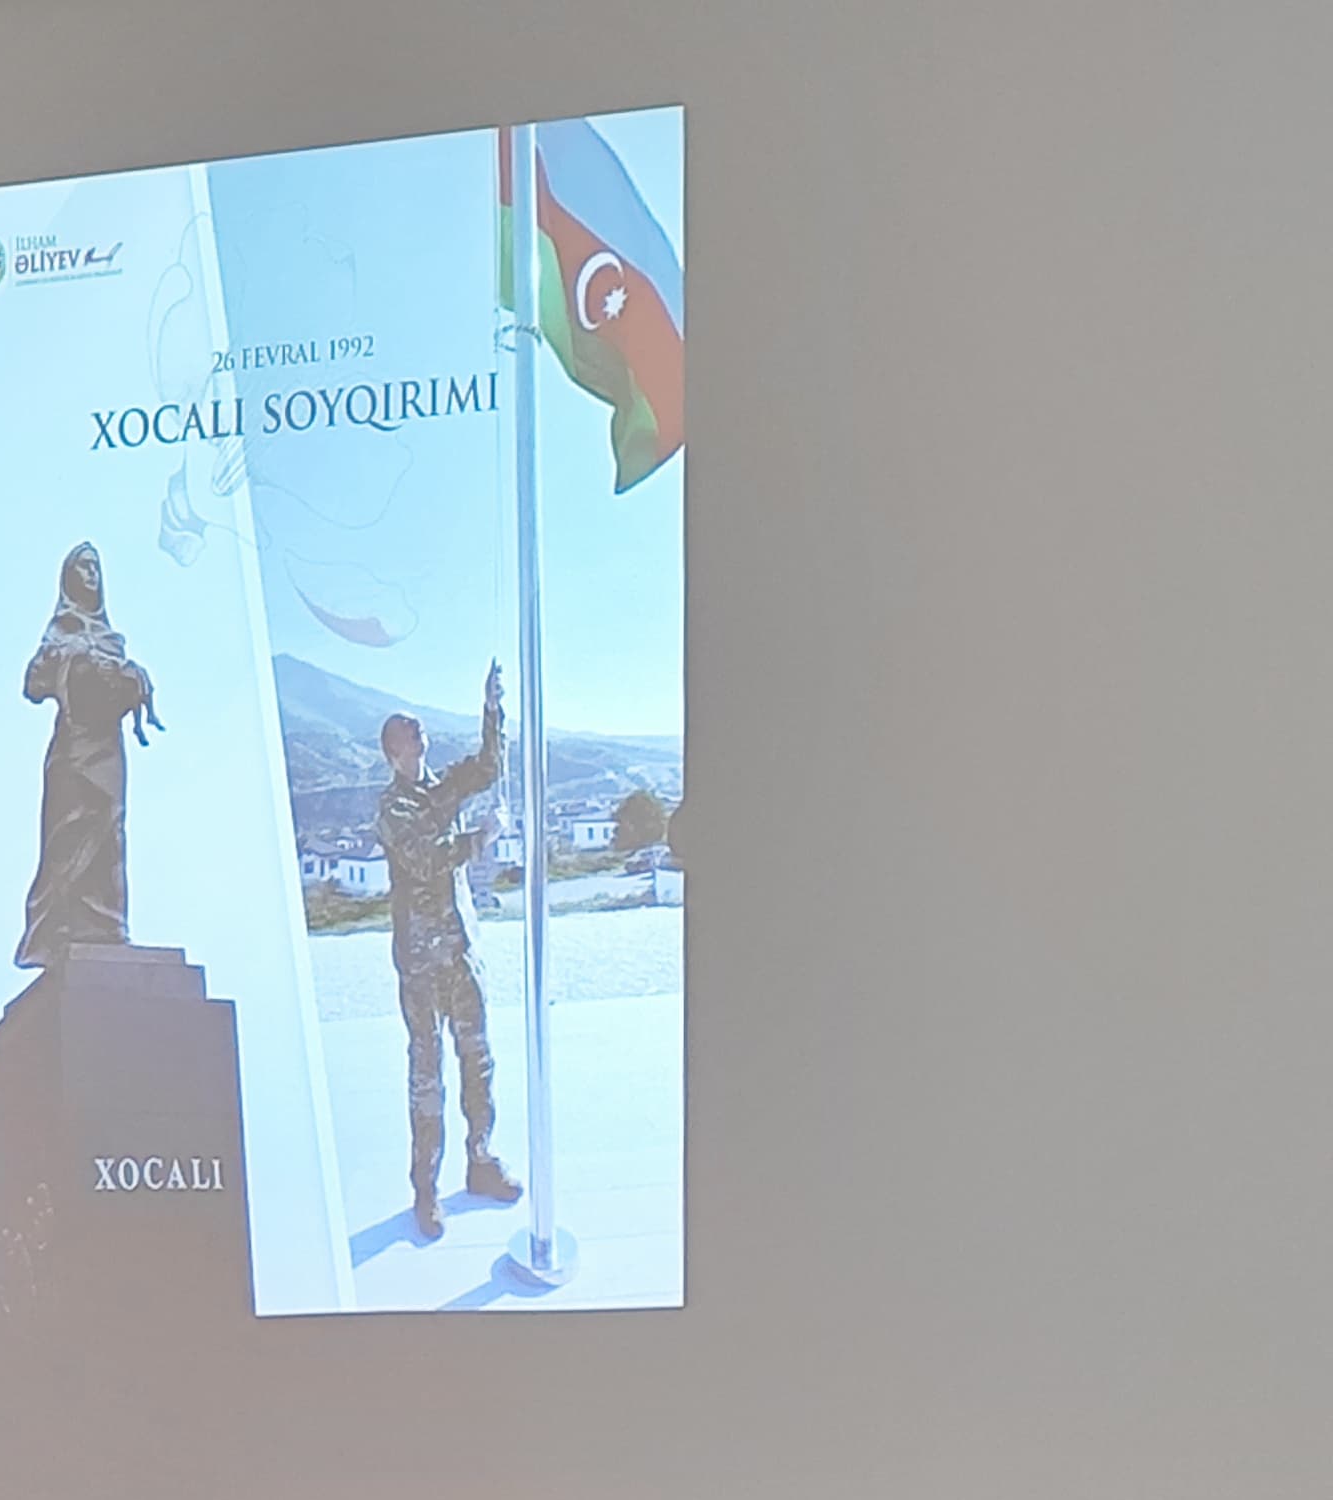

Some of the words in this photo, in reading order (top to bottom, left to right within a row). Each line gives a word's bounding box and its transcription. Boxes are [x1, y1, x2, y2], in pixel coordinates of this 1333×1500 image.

[212, 349, 235, 374] 26
[242, 342, 320, 370] FEVRAL
[330, 335, 375, 360] 1992
[90, 398, 245, 450] XOCALI
[262, 372, 500, 433] SOYQIRIMI
[94, 1157, 224, 1190] XOCALI
